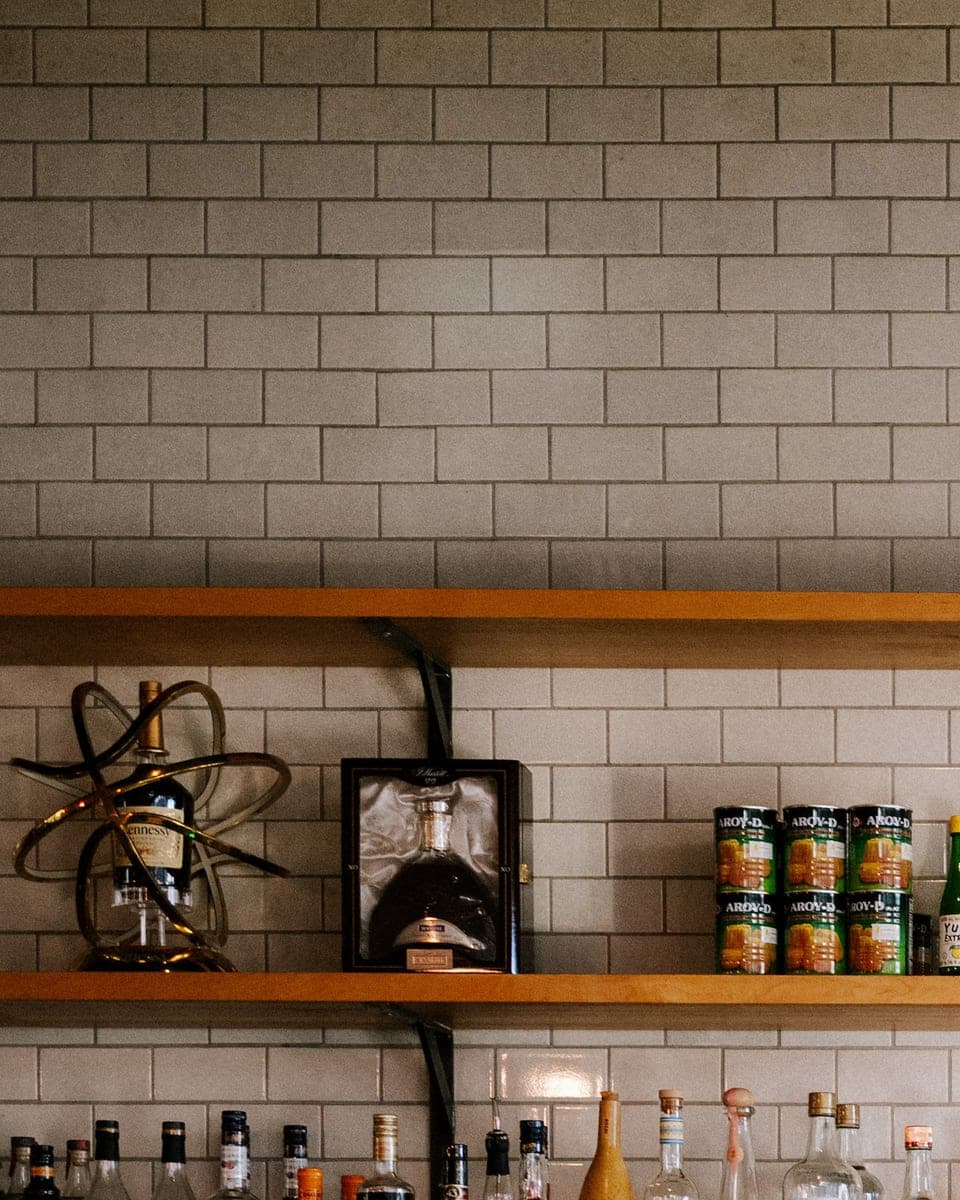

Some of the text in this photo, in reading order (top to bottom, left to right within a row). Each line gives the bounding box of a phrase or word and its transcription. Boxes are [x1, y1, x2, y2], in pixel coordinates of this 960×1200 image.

[792, 816, 838, 828] AROY-D
[867, 814, 910, 828] AROY-D
[127, 826, 170, 838] ennessy
[726, 901, 771, 914] AROY-D
[791, 901, 836, 913] AROY-D
[850, 900, 885, 912] ROY-D
